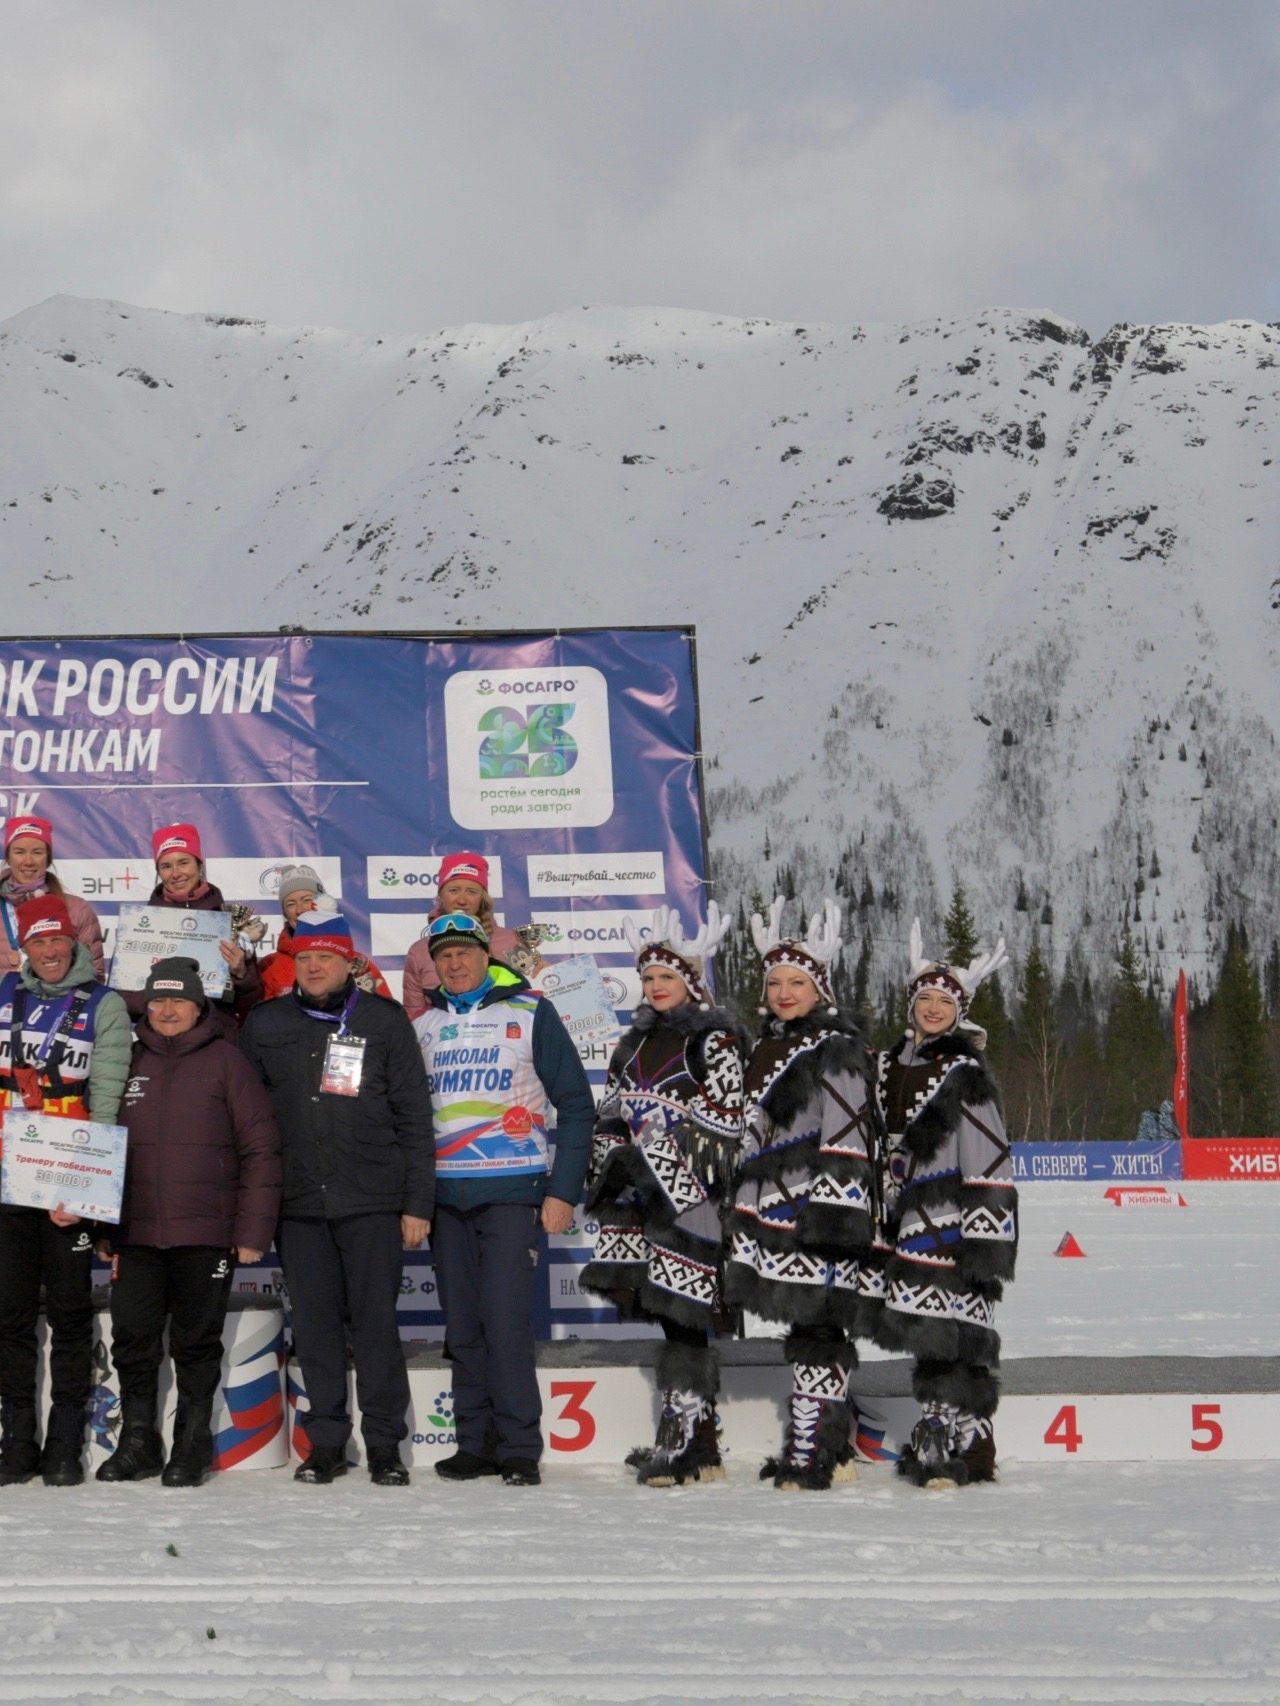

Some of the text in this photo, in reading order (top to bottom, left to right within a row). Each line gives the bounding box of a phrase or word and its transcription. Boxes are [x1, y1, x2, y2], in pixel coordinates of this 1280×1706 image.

[53, 656, 278, 716] РОССИИ
[498, 680, 576, 694] ФОСАГРО
[480, 786, 581, 801] растём сегодня
[491, 803, 572, 816] ради завтра
[536, 869, 657, 886] #Выигрывай_честно
[433, 1045, 501, 1068] НИКОЛАЙ
[15, 1154, 113, 1176] Тренеру победителя
[1032, 1155, 1088, 1176] СЕВЕРЕ
[1111, 1154, 1163, 1175] ЖИТЬ!
[35, 1169, 53, 1182] 30
[54, 1171, 81, 1187] 000
[1128, 1196, 1172, 1204] ХИБИНЫ
[560, 1279, 576, 1295] НА
[549, 1380, 597, 1452] 3
[1044, 1405, 1083, 1453] 4
[1190, 1404, 1224, 1452] 5
